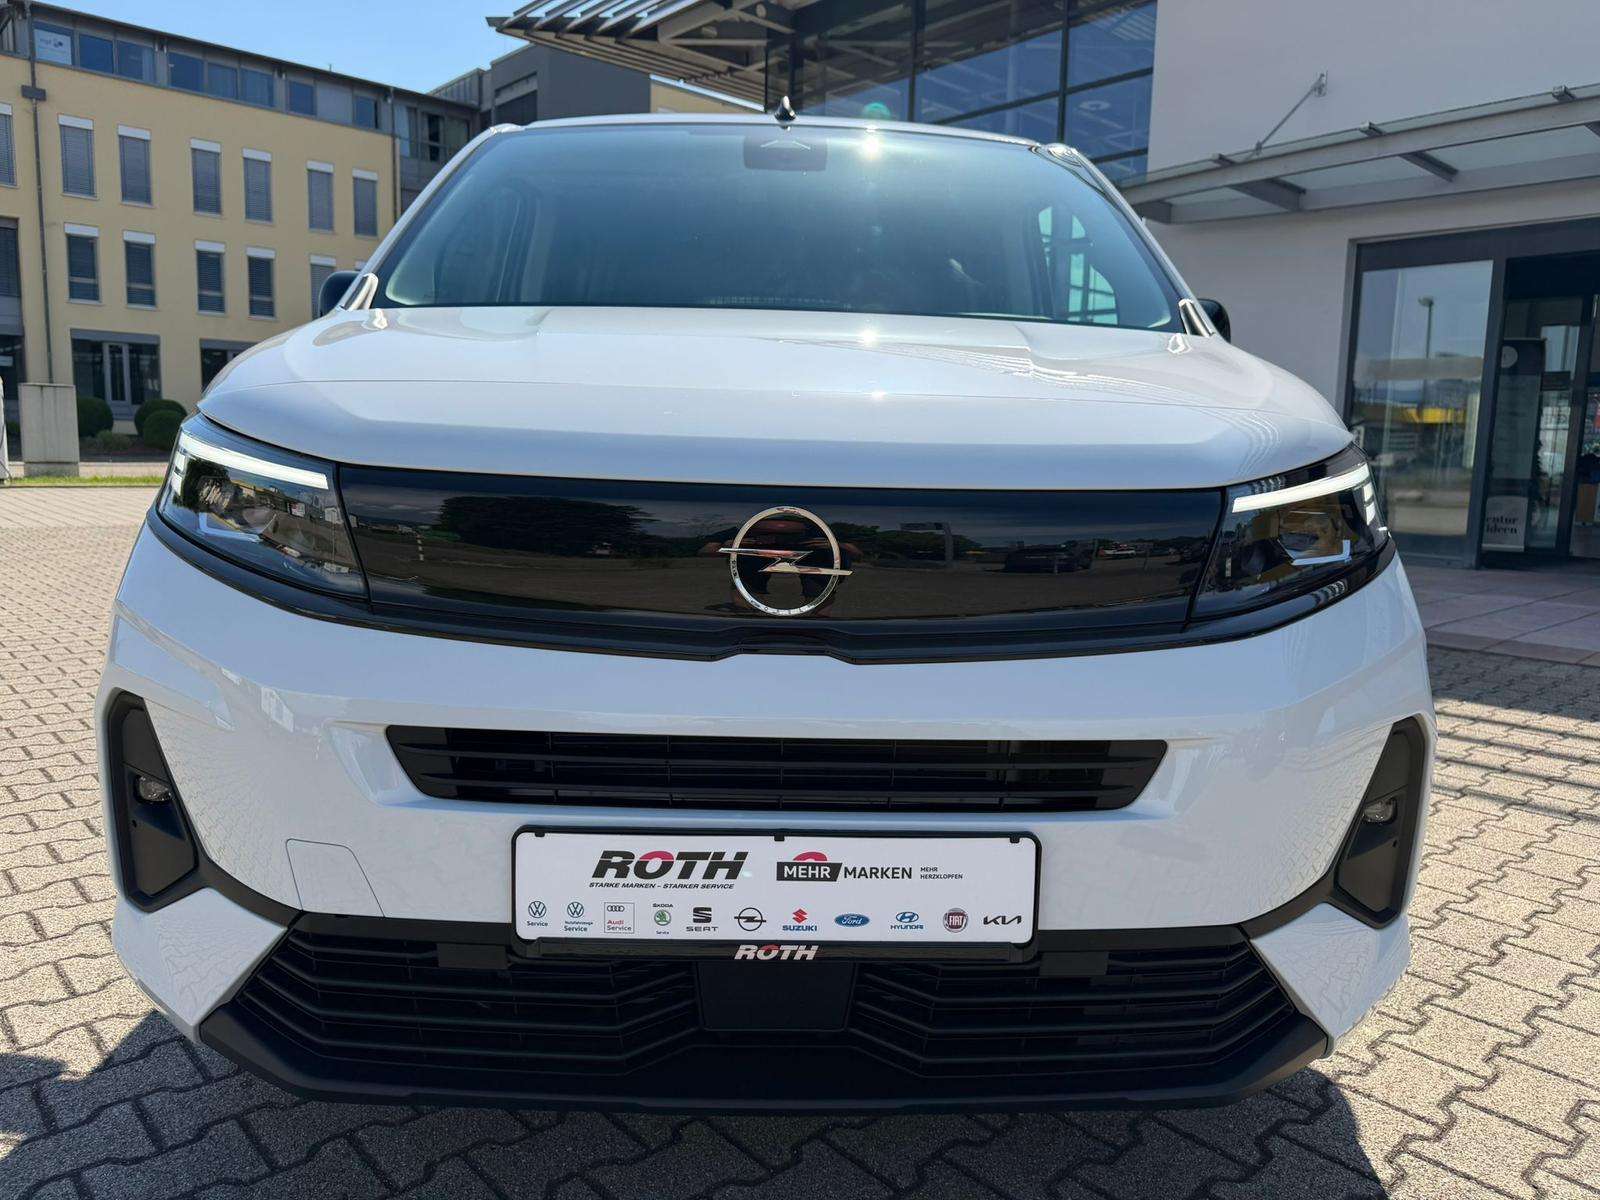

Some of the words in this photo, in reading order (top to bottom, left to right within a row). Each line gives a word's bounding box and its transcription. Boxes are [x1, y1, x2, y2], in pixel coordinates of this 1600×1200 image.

[592, 850, 749, 880] ROTH
[783, 865, 831, 879] MEHR
[844, 866, 913, 880] MARKEN
[841, 916, 863, 925] Ford
[948, 915, 964, 926] FIAT
[734, 944, 819, 960] ROTH
